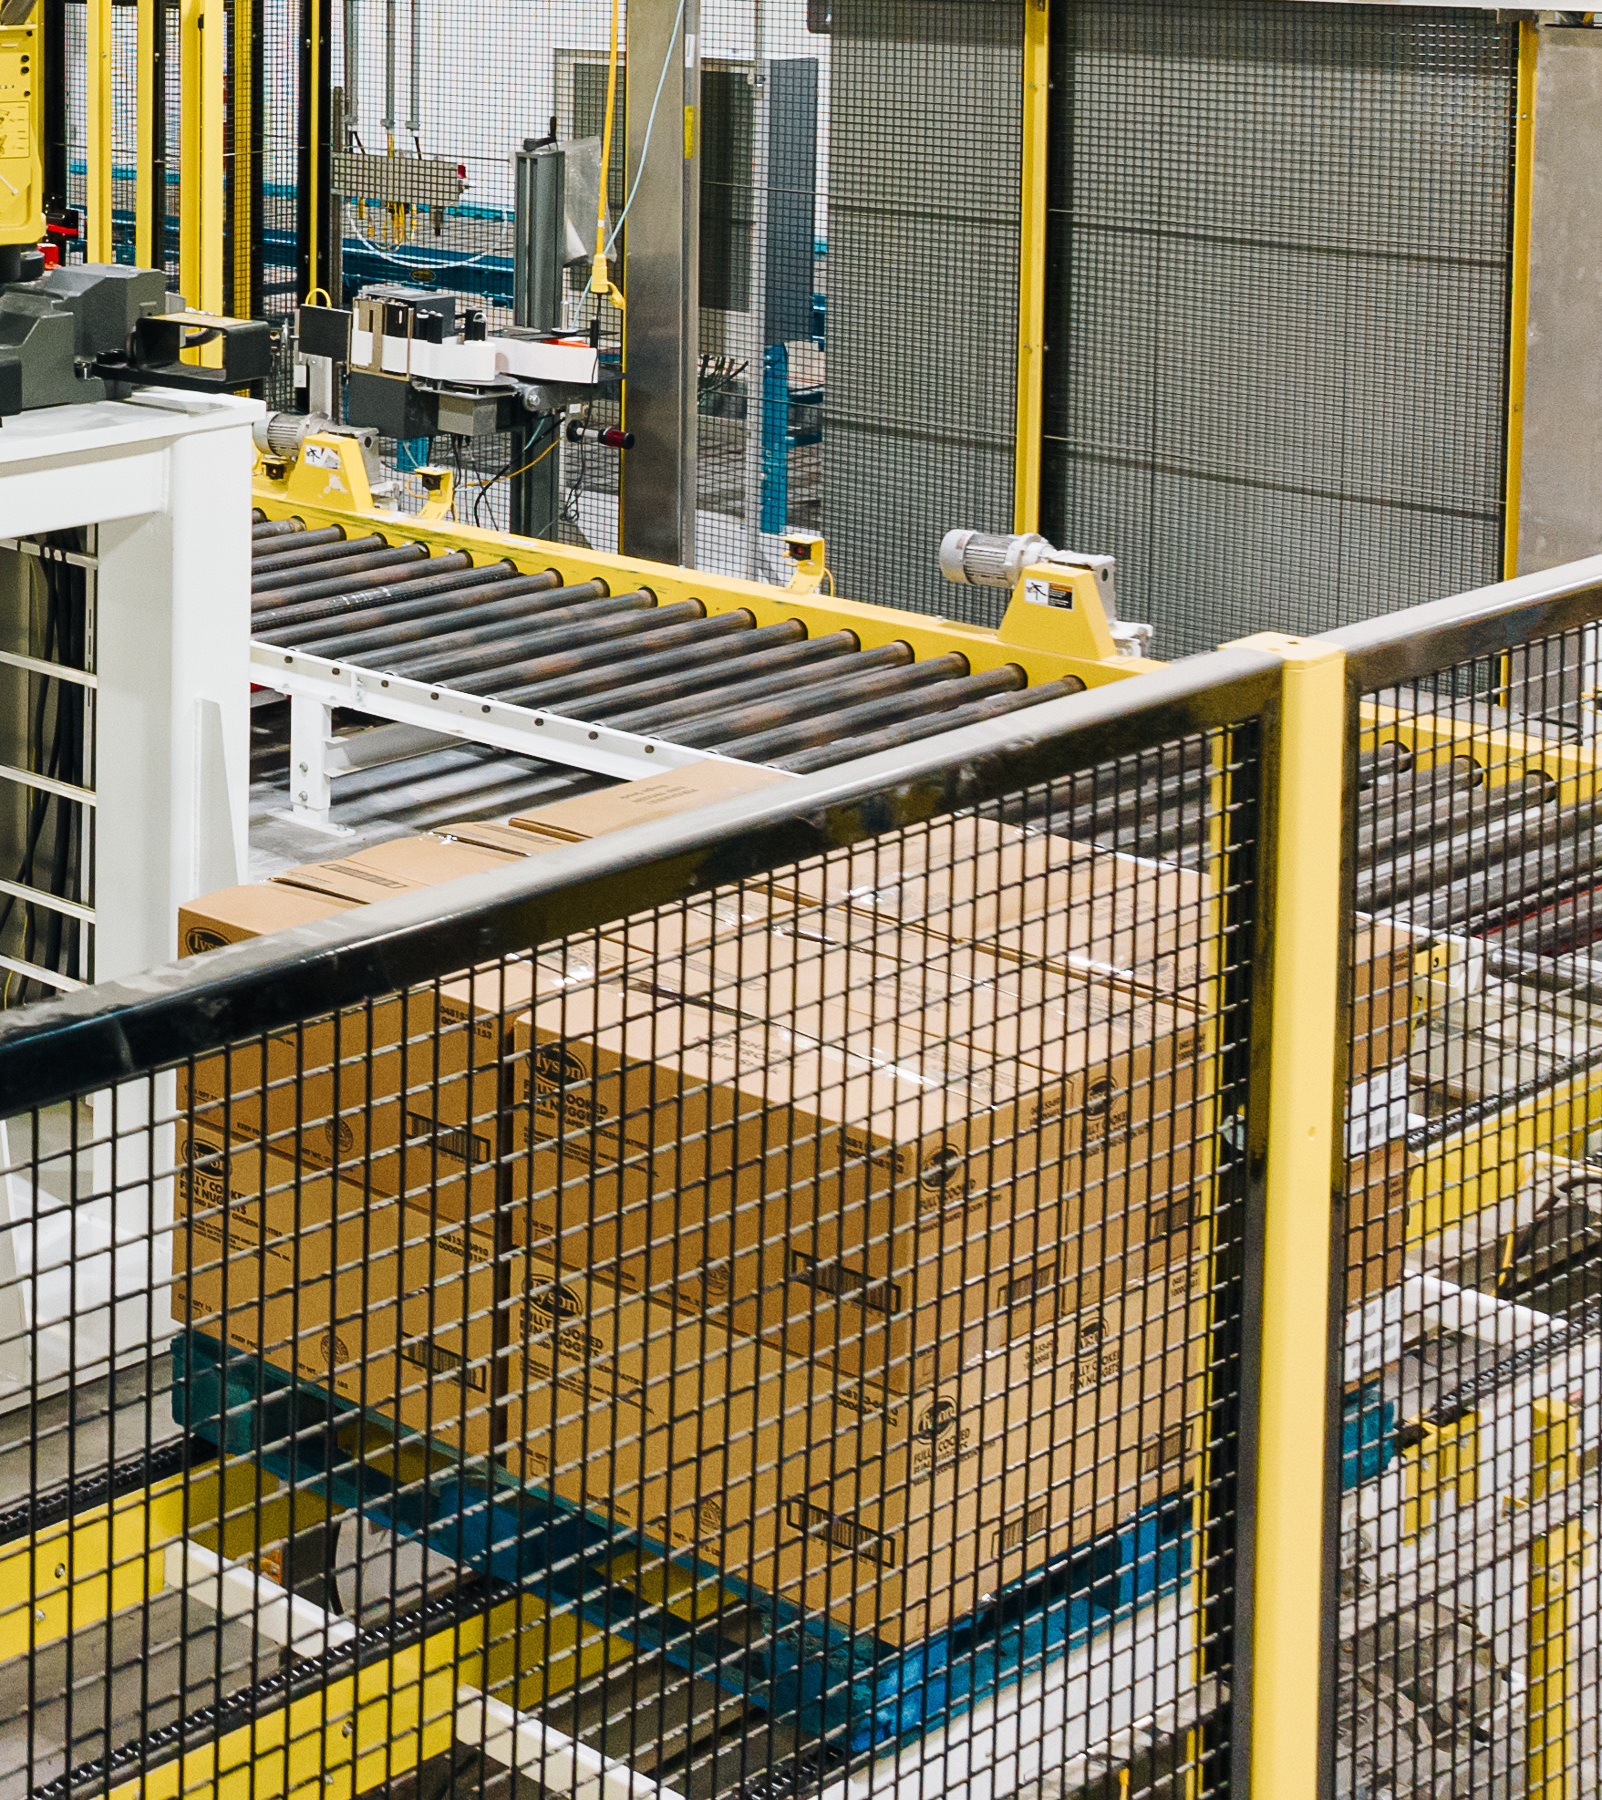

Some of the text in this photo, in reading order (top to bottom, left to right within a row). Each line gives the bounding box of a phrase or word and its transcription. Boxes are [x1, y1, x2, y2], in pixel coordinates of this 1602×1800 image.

[180, 1172, 247, 1201] FLLY COKE
[180, 1180, 199, 1195] FN
[232, 1212, 258, 1228] CHICKEN
